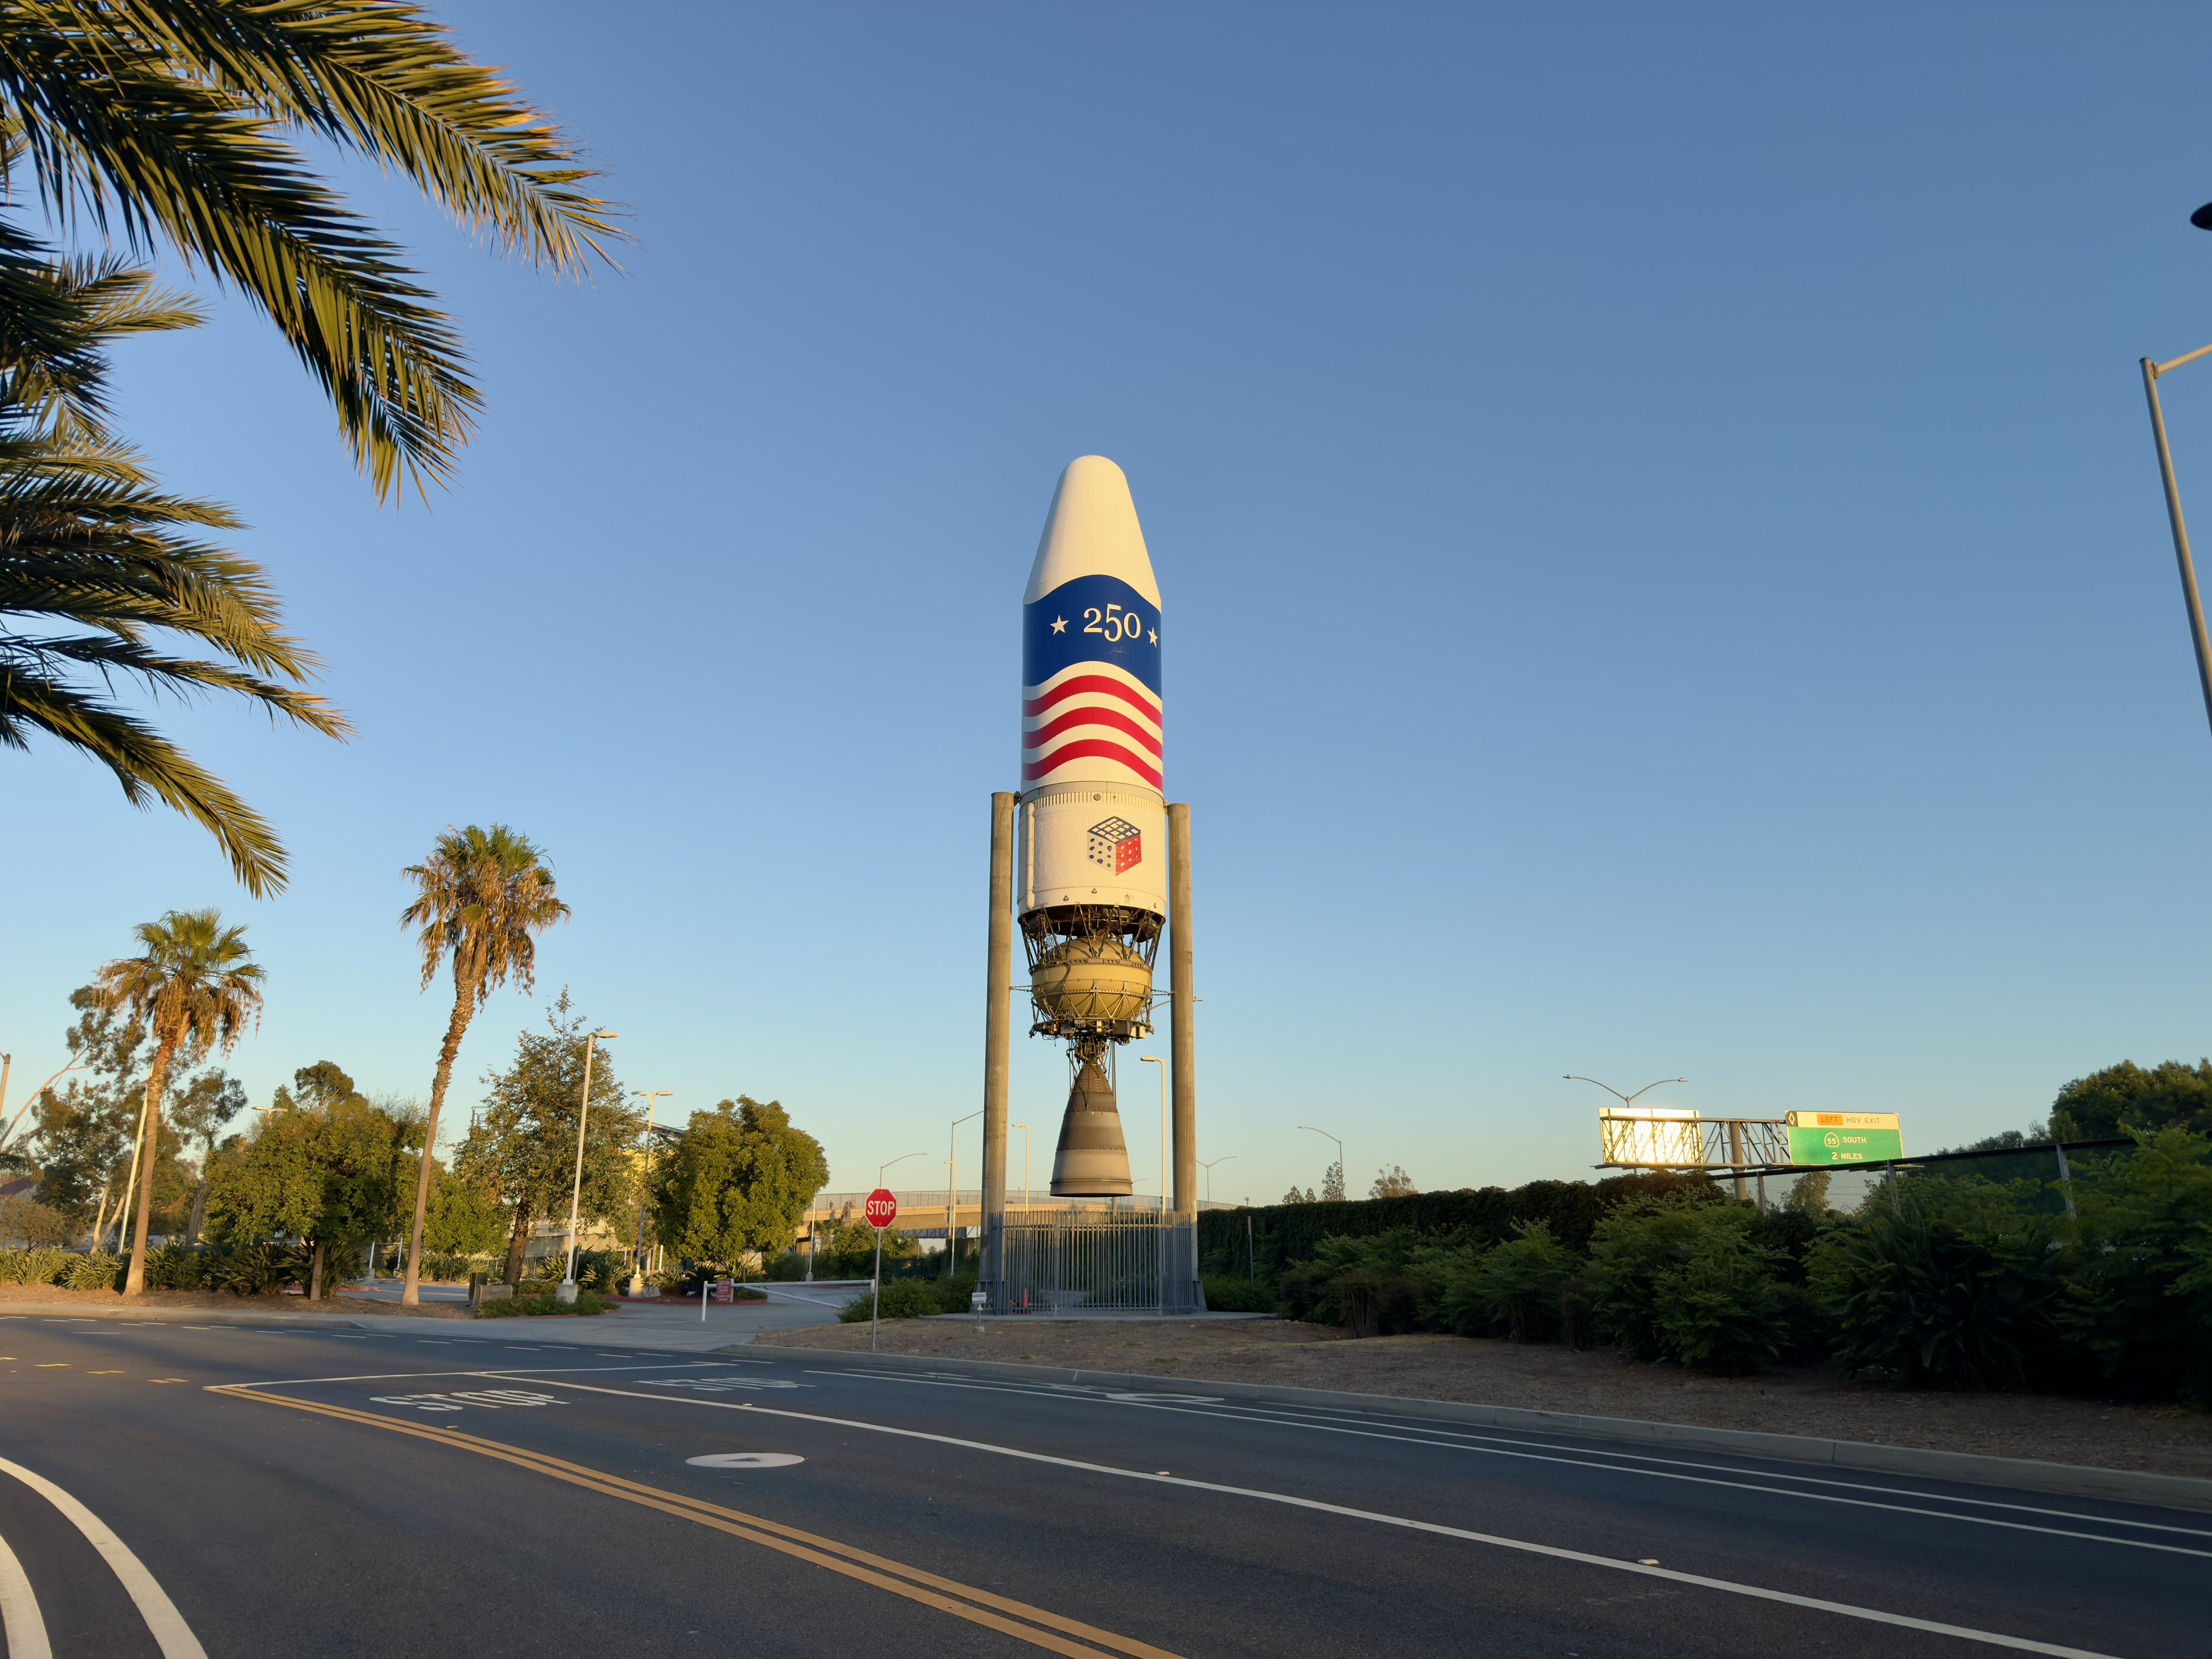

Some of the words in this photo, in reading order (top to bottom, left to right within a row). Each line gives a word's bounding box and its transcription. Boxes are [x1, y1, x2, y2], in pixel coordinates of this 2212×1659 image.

[1083, 603, 1141, 642] 250
[1831, 1151, 1838, 1160] 2
[867, 1200, 895, 1216] STOP
